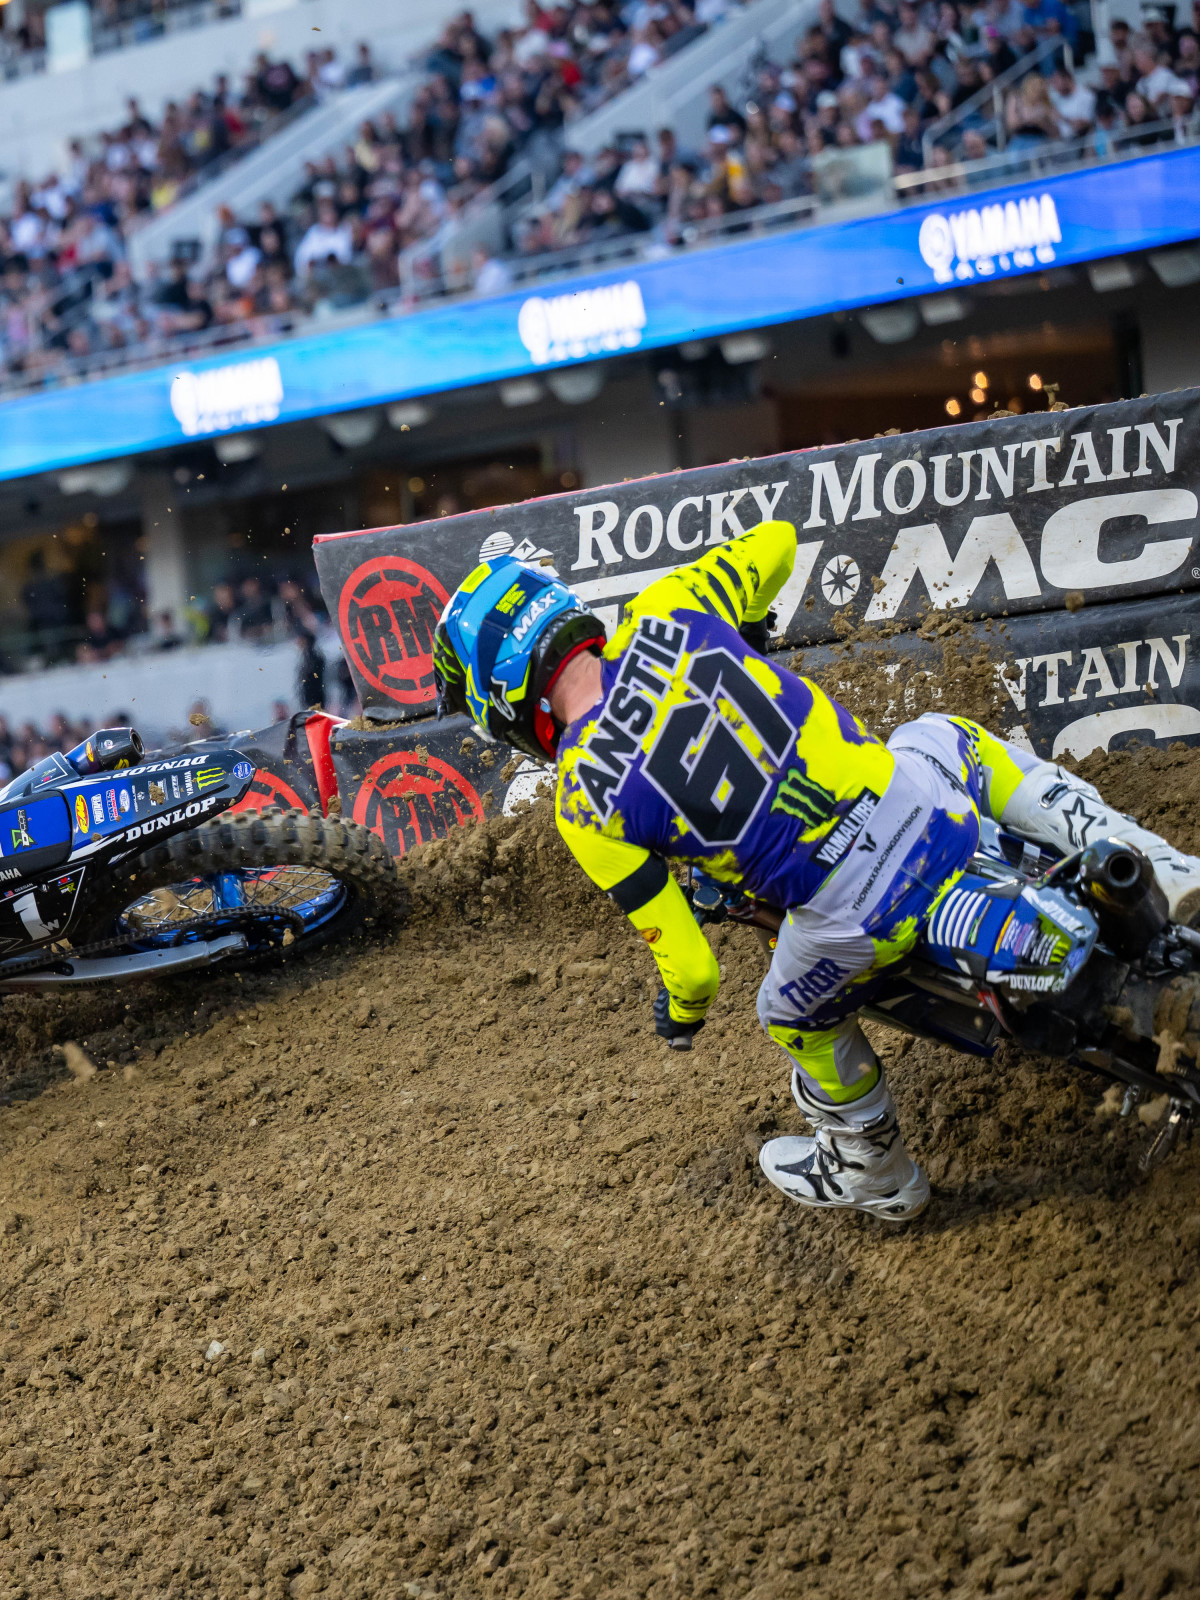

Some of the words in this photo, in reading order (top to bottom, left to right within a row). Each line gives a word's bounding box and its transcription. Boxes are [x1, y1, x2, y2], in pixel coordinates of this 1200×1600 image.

[950, 194, 1062, 260] YAMAHA
[570, 481, 788, 570] ROCKY
[803, 418, 1183, 527] MOUNTAIN
[513, 592, 557, 642] MAX
[576, 616, 689, 825] ANSTIE
[112, 754, 210, 779] DUNLOP
[184, 770, 194, 796] YAMAHA
[126, 796, 216, 842] DUNLOP
[13, 892, 50, 941] 1
[779, 958, 850, 1014] THOR
[1010, 974, 1054, 992] DUNLOP
